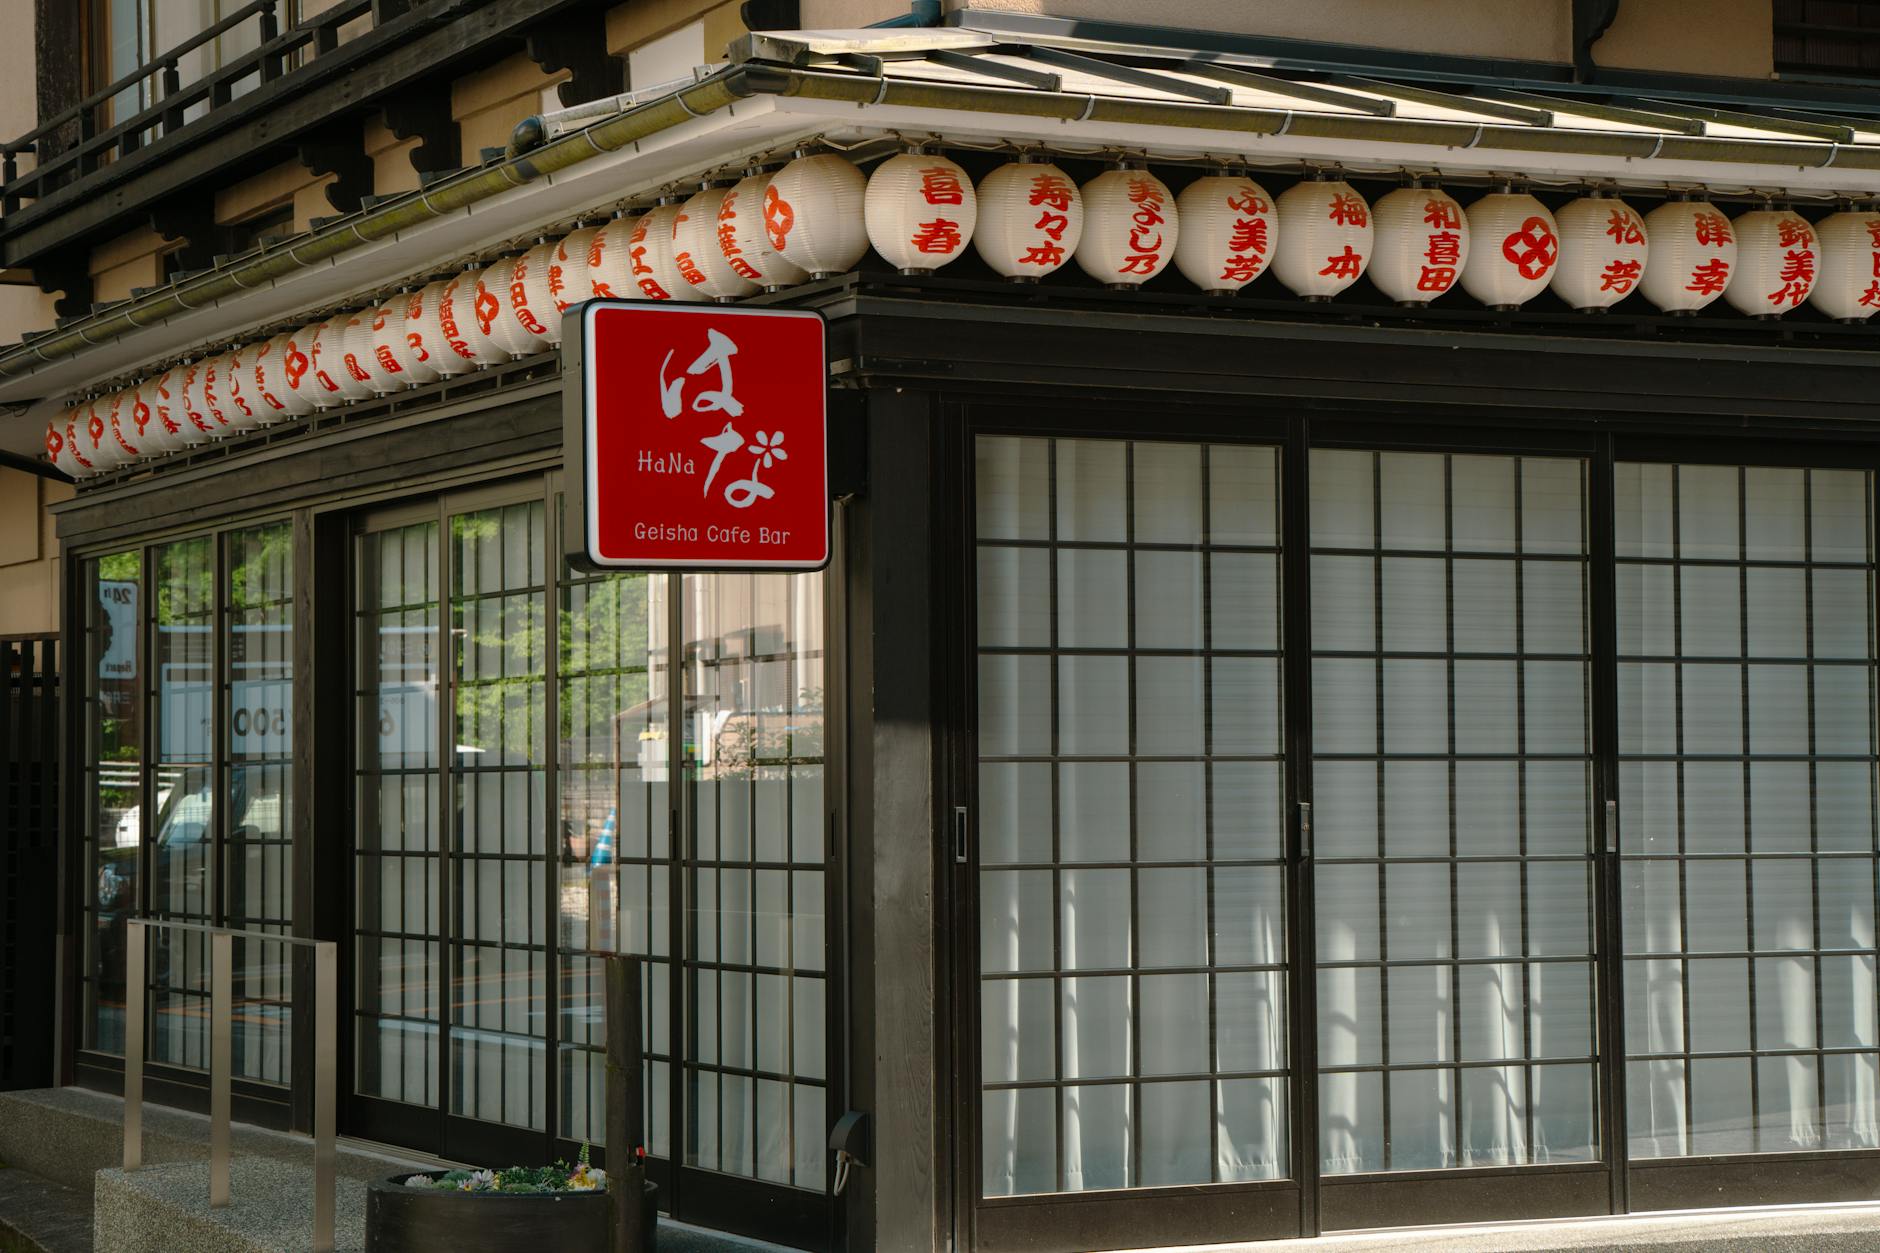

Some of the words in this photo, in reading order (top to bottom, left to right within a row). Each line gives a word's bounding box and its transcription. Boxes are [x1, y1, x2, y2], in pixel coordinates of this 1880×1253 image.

[659, 328, 788, 509] はな
[637, 450, 696, 475] HaNa
[633, 522, 698, 542] Geisha
[706, 525, 751, 544] Cafe
[758, 526, 791, 545] Bar
